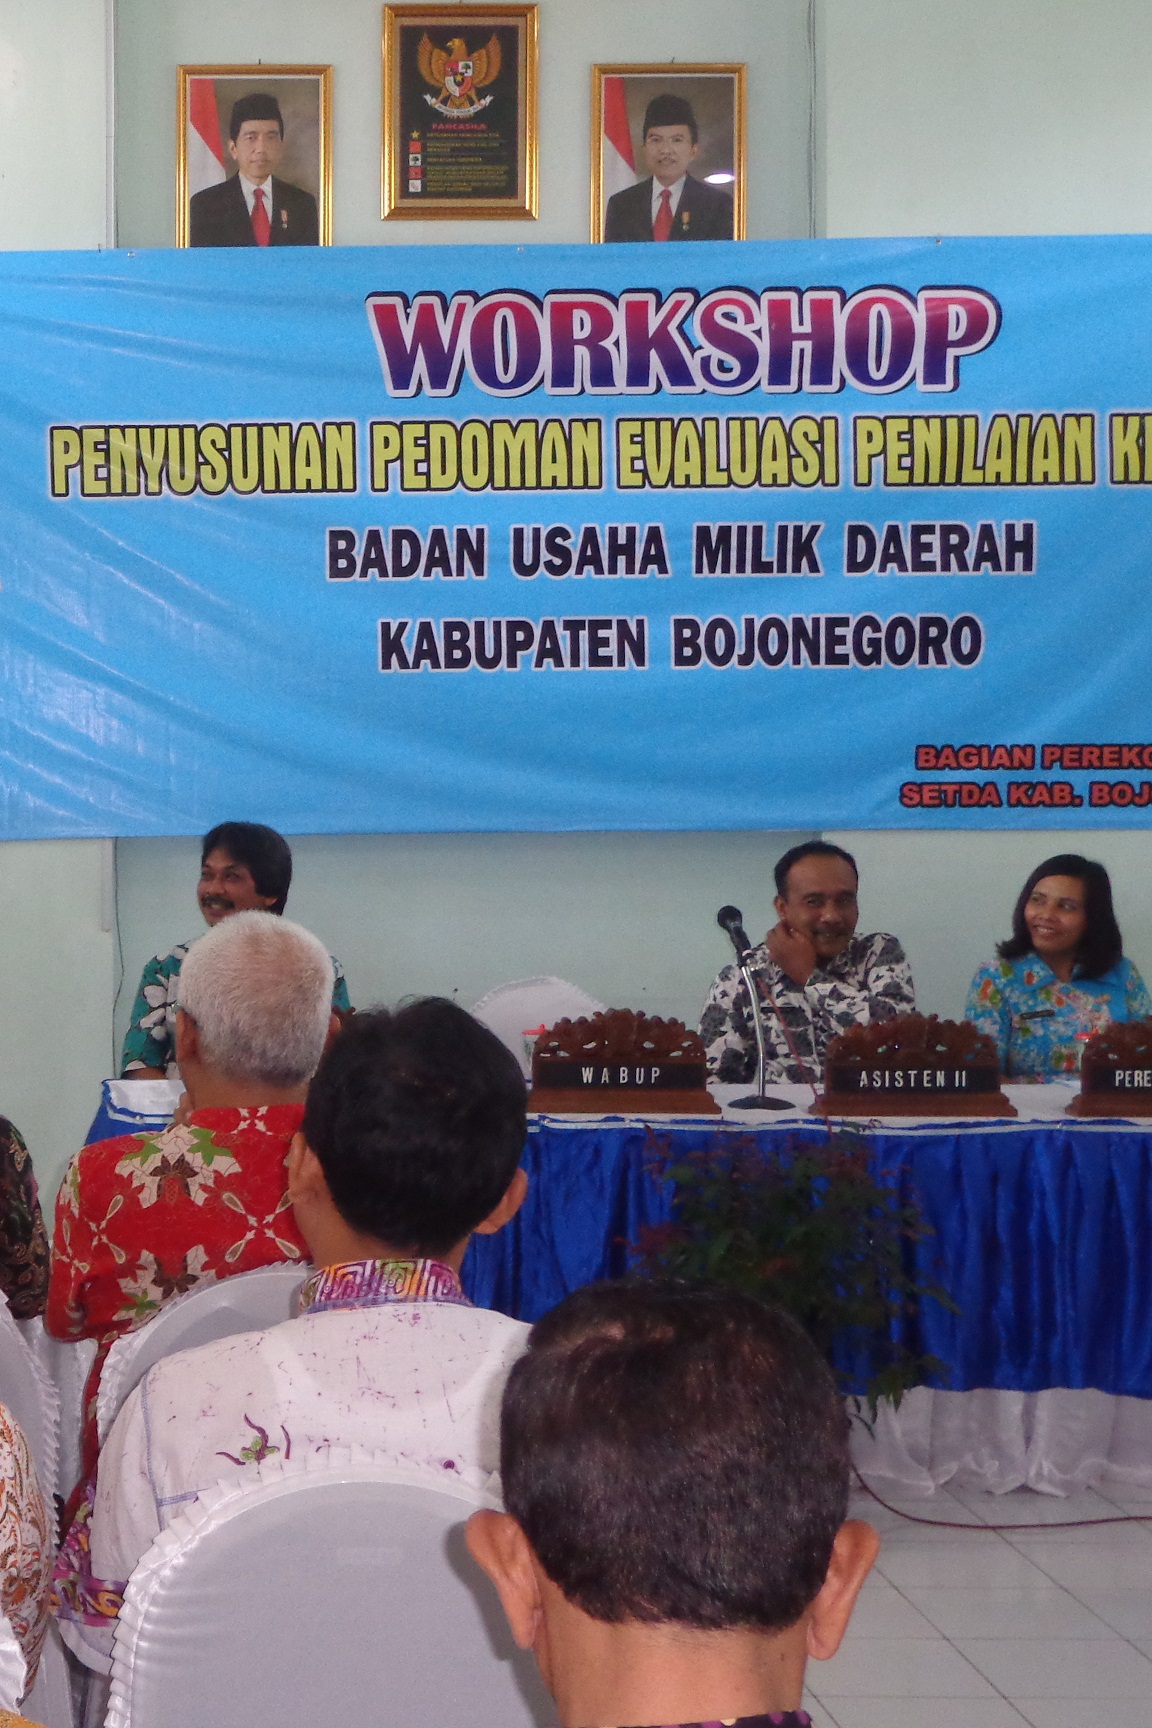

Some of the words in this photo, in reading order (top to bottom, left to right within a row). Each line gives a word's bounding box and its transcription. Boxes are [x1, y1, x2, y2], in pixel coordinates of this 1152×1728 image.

[365, 288, 1000, 397] WORKSHOP
[50, 422, 356, 496] PENYUSUNAN
[370, 419, 601, 492] PEDOMAN
[616, 416, 839, 488] EVALUASI
[853, 414, 1095, 486] PENILAIAN
[327, 527, 485, 578] BADAN
[511, 525, 670, 576] USAHA
[694, 524, 822, 575] MILIK
[846, 522, 1034, 573] DAERAH
[379, 619, 646, 670] KABUPATEN
[673, 616, 983, 668] BOJONEGORO
[915, 744, 1035, 770] BAGIAN
[900, 782, 1002, 808] SETDA
[1007, 781, 1084, 808] KAB.
[1089, 781, 1152, 807] BOJ
[581, 1066, 661, 1084] WABUP
[859, 1070, 945, 1088] ASISTEN
[954, 1070, 966, 1088] II
[1115, 1070, 1152, 1087] PERE
